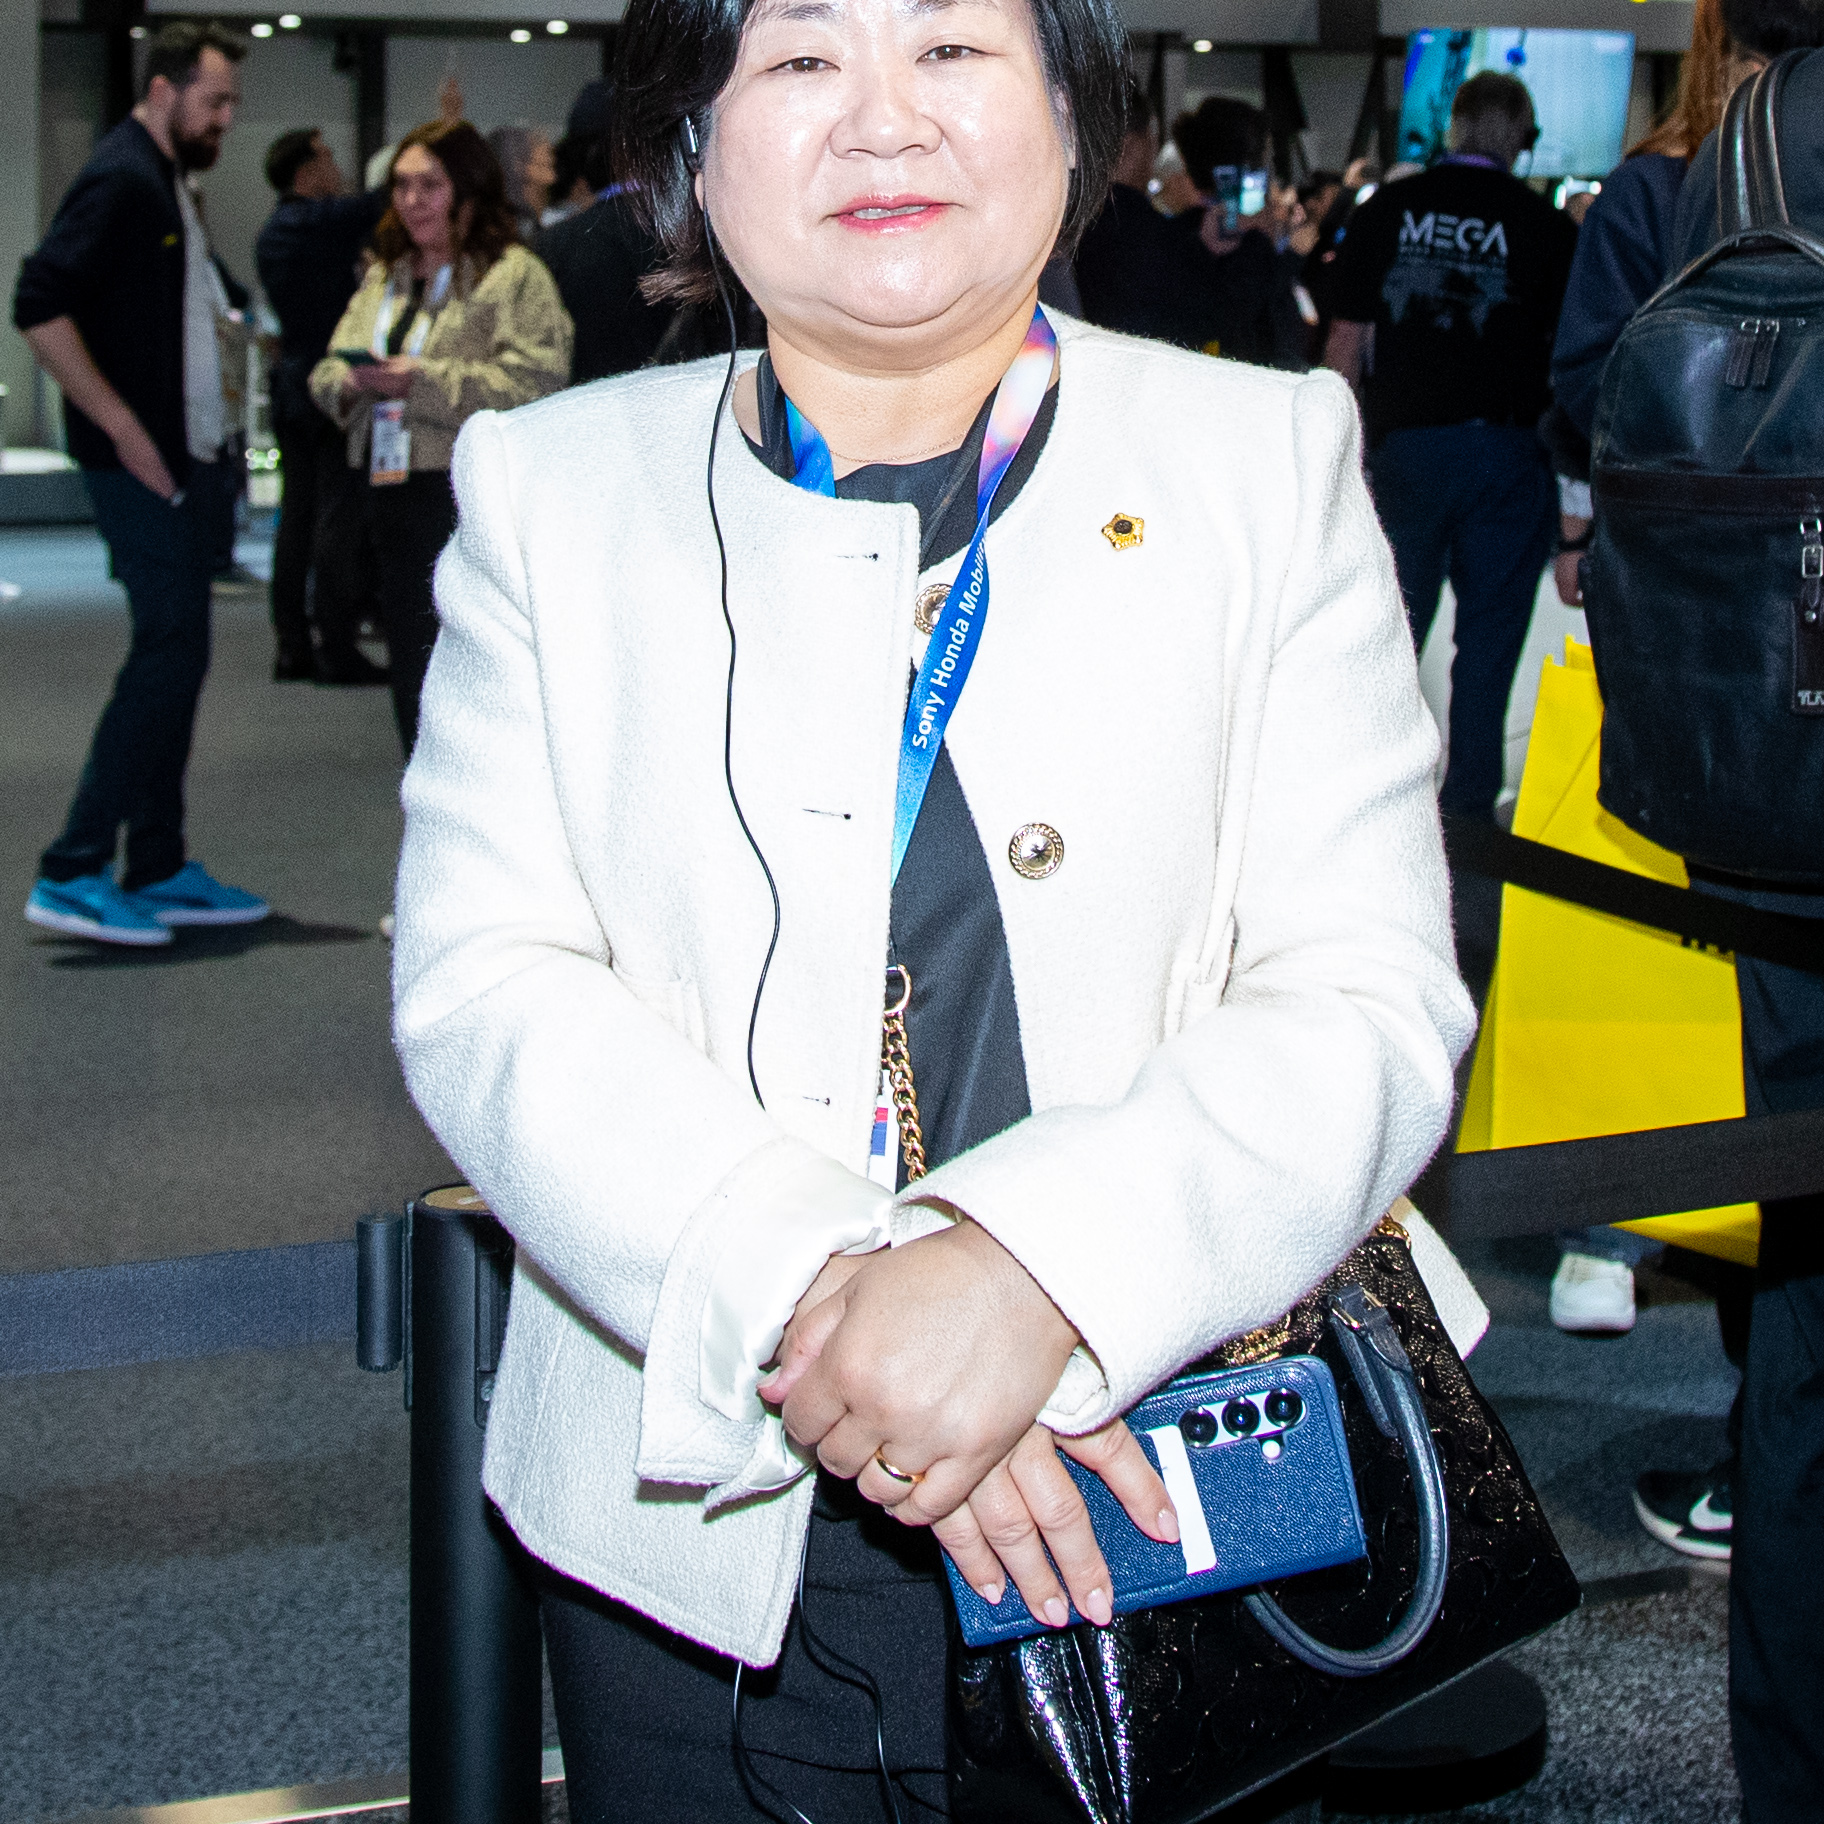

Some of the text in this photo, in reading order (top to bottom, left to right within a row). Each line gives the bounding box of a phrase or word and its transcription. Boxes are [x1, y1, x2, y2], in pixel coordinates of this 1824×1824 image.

[1398, 209, 1508, 257] MEGA
[912, 690, 946, 750] Sony
[929, 617, 971, 688] Honda
